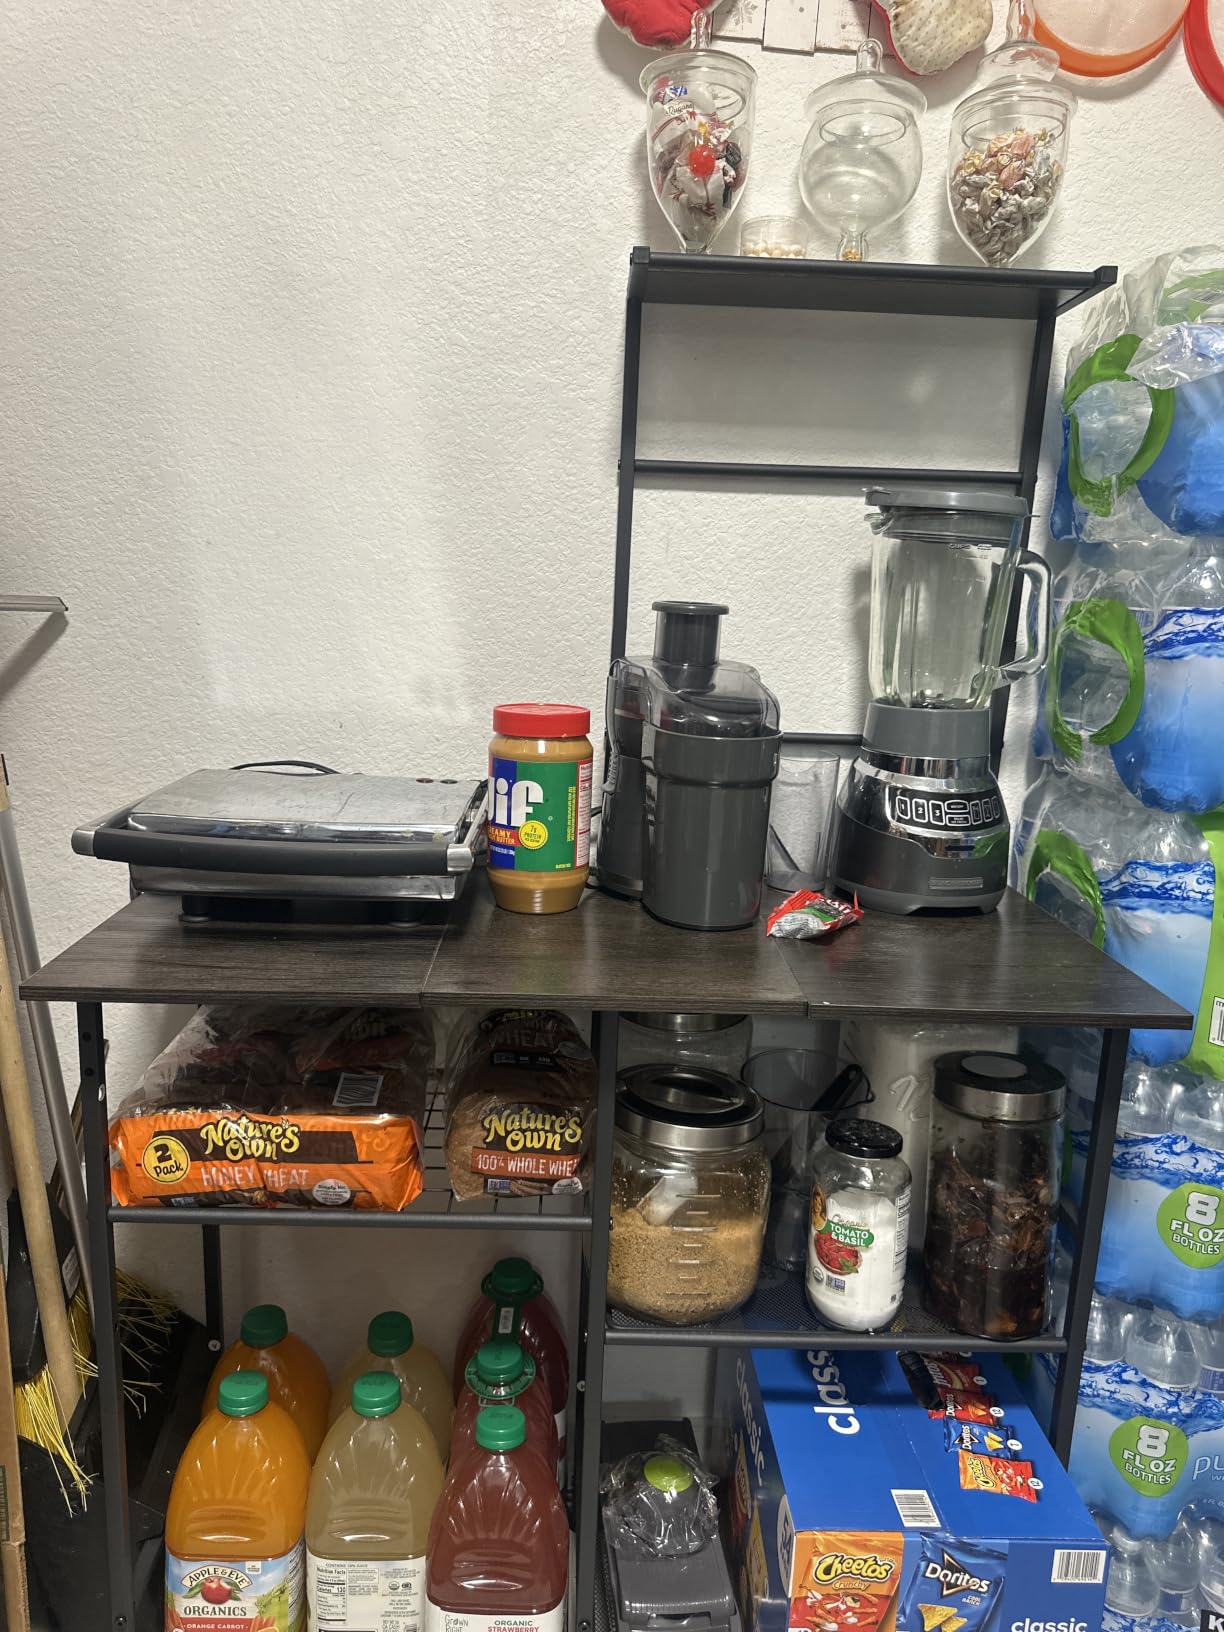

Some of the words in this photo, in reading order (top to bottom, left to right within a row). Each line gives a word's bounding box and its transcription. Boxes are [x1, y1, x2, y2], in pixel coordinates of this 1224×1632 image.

[200, 1116, 300, 1155] Nature's
[484, 1107, 582, 1143] Nature's
[226, 1139, 277, 1161] Own
[506, 1130, 561, 1151] Own
[153, 1143, 173, 1164] 2
[477, 1155, 504, 1170] 100%
[507, 1156, 546, 1174] WHOLE
[153, 1162, 183, 1177] Pack
[201, 1164, 256, 1187] HONEY
[263, 1167, 309, 1188] HEAT
[1185, 1191, 1220, 1226] 8
[830, 1222, 869, 1239] TOMATO
[831, 1231, 838, 1240] &
[838, 1234, 866, 1247] BASIL
[1170, 1219, 1194, 1237] FL
[1172, 1233, 1221, 1254] BOTTLES
[807, 1350, 860, 1434] class
[962, 1425, 972, 1450] Doritos
[1137, 1425, 1170, 1458] 8
[1122, 1448, 1145, 1469] FL
[1150, 1459, 1176, 1473] OZ
[968, 1457, 995, 1487] Cheetos
[1124, 1463, 1171, 1485] BOTTLES
[188, 1567, 220, 1586] APPLE
[229, 1570, 247, 1586] EVE
[815, 1554, 893, 1582] Cheetos
[925, 1562, 990, 1592] Doritos
[832, 1581, 871, 1591] Crunchy
[184, 1606, 247, 1617] ORGANICS
[1011, 1617, 1088, 1632] classic
